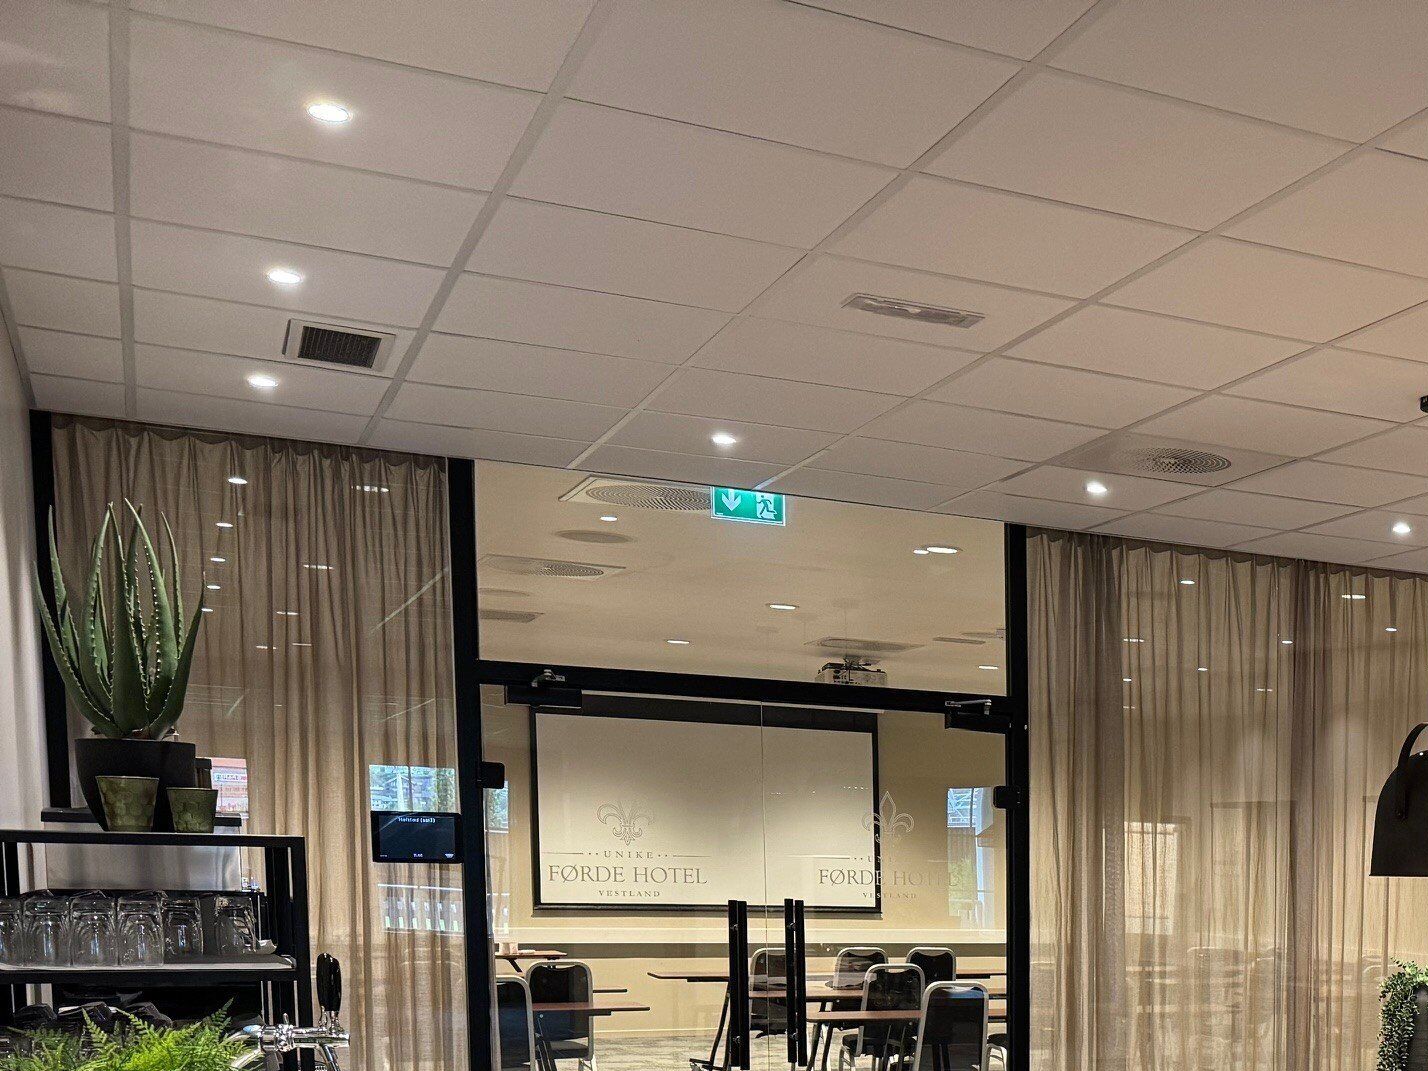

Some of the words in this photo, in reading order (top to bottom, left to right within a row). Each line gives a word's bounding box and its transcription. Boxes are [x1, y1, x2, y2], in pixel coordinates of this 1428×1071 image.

[604, 850, 654, 859] UNIKE
[548, 864, 626, 883] FØRDE
[633, 866, 708, 884] HOTEL
[598, 890, 660, 898] VESTLAND
